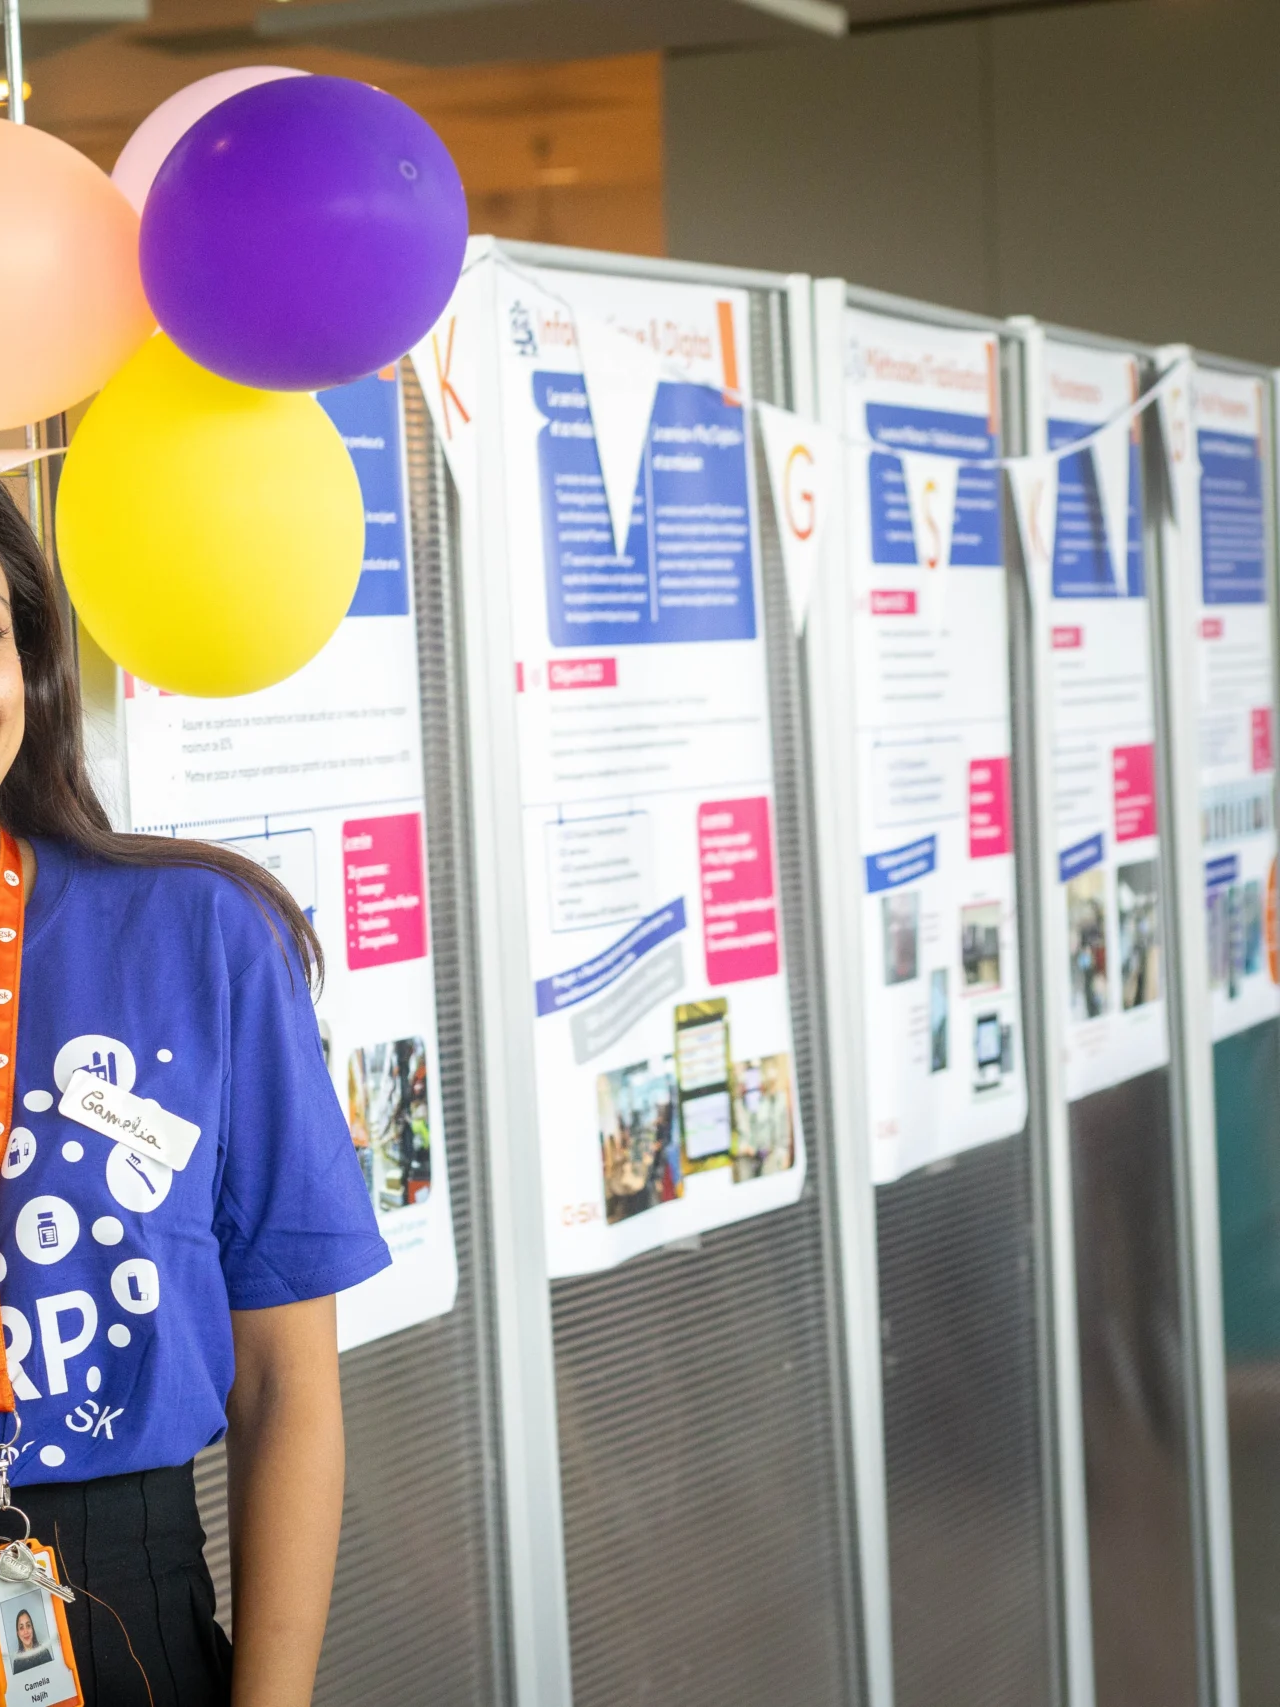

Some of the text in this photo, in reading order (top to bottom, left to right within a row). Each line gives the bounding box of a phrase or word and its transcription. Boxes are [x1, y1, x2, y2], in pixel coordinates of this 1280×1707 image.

[432, 316, 471, 440] K
[784, 444, 817, 541] G
[24, 1676, 51, 1692] Camelia
